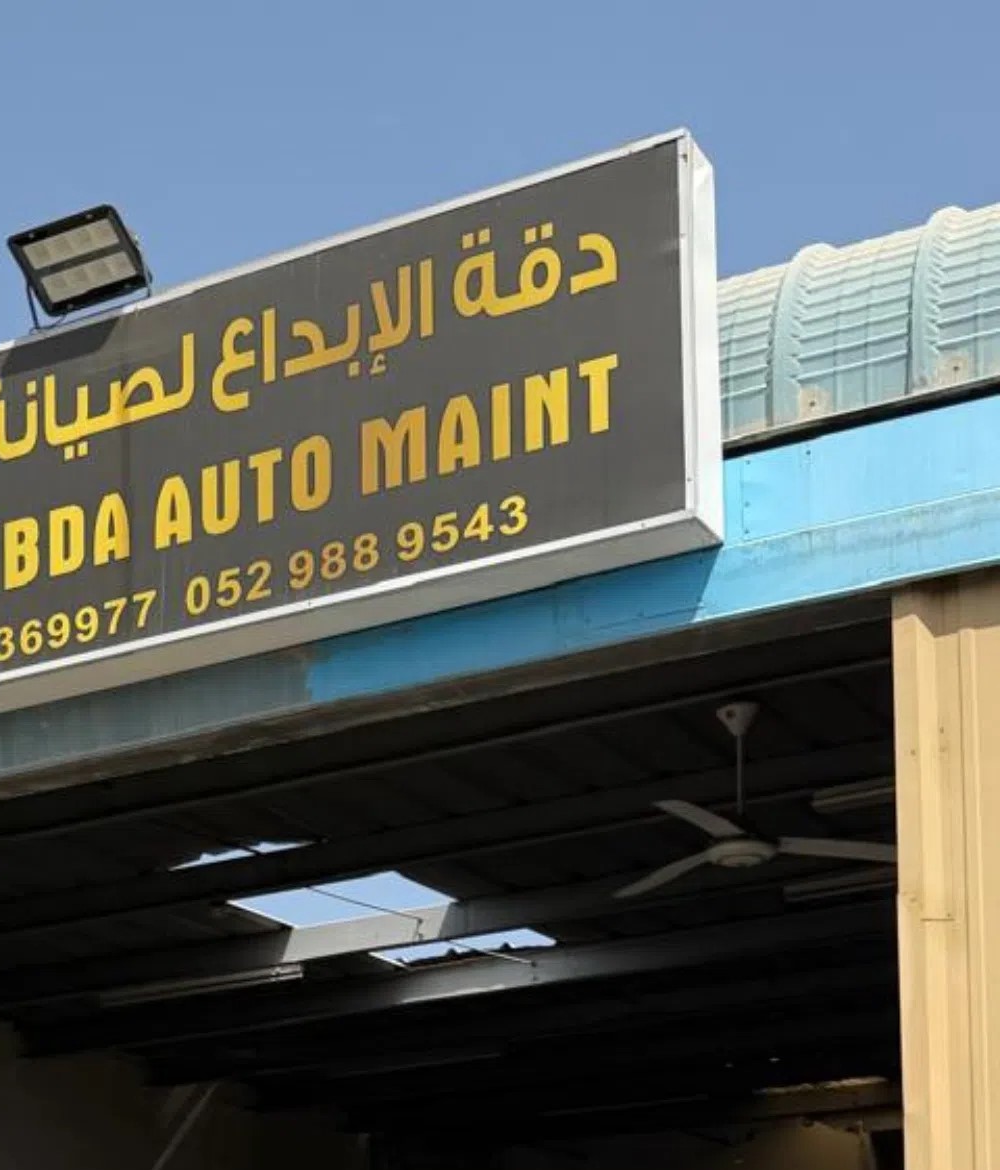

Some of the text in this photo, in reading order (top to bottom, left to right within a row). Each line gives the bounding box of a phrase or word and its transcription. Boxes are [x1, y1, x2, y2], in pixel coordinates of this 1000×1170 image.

[210, 258, 435, 415] الإبداع
[453, 222, 619, 317] دقة
[153, 435, 332, 550] AUTO
[360, 353, 619, 496] MAINT
[185, 559, 272, 618] 052
[289, 533, 380, 592] 988
[396, 494, 529, 562] 9543
